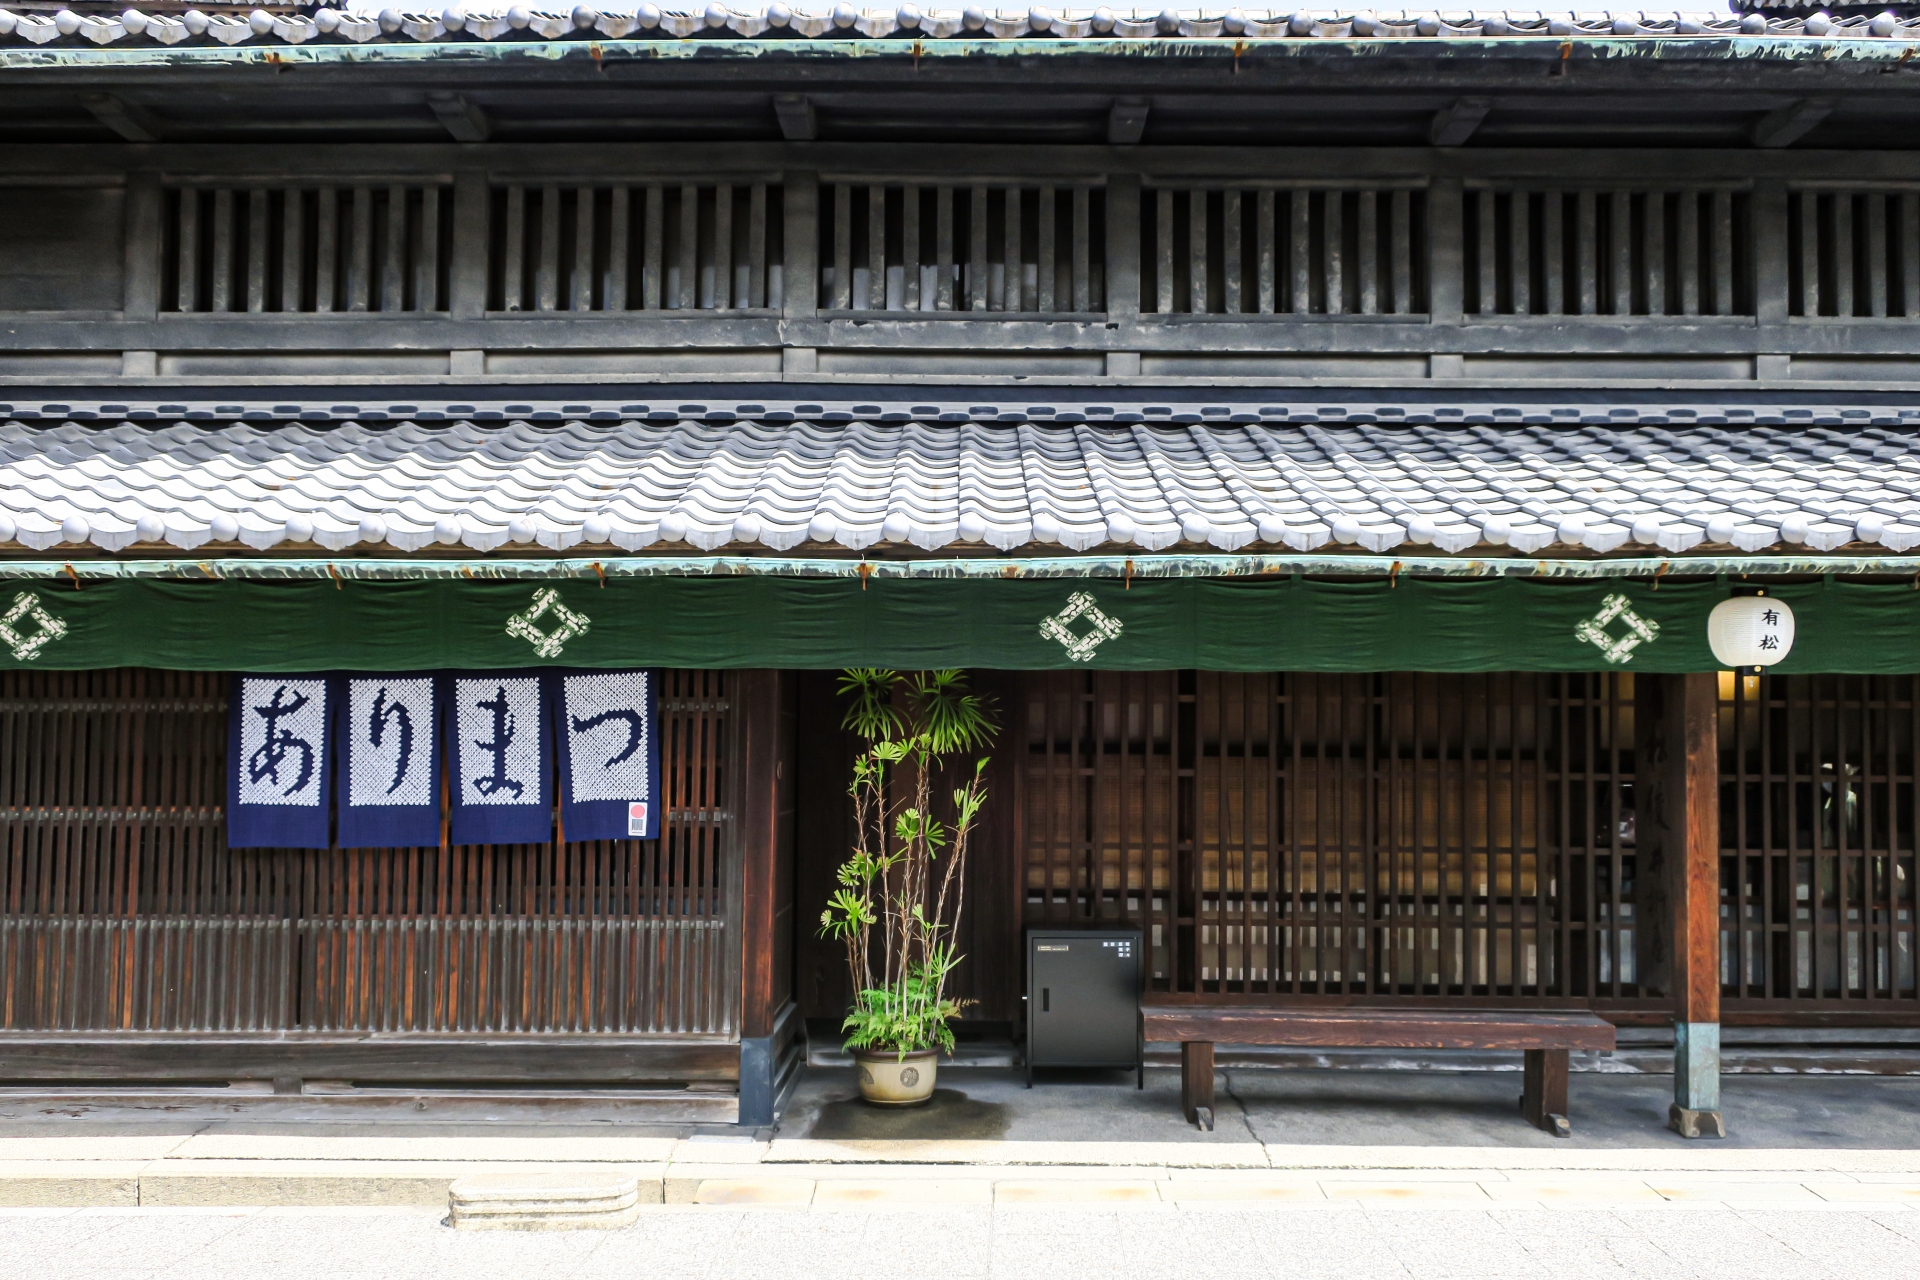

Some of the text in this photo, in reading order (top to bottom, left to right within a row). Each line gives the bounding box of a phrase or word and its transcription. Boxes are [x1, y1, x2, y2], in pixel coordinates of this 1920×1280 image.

[1758, 609, 1780, 650] 有松
[249, 684, 643, 799] ありまつ
